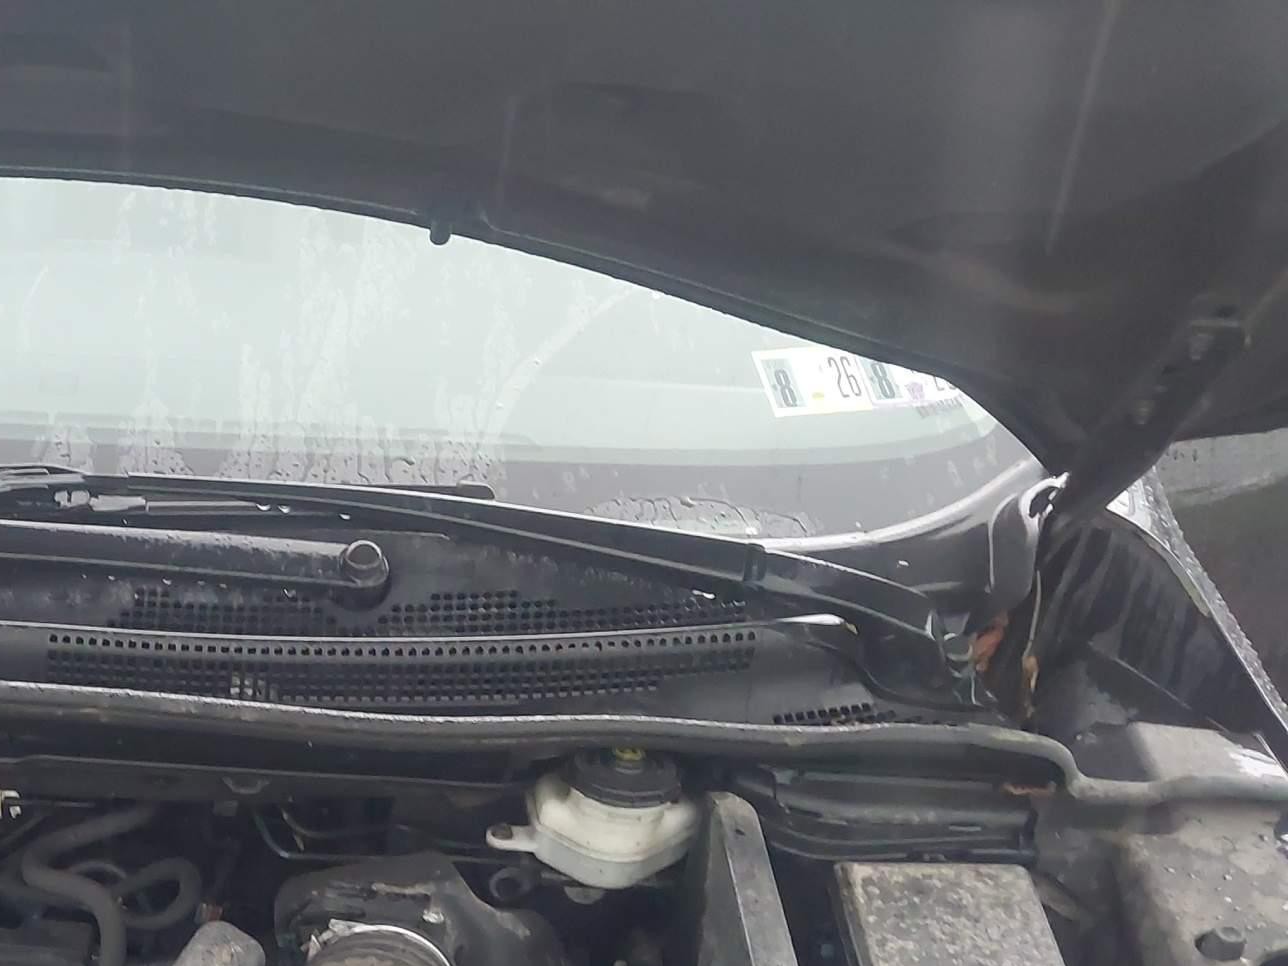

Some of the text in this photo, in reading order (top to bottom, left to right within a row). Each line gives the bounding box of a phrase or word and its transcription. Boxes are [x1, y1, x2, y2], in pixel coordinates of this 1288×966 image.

[773, 355, 862, 408] 8 26
[870, 361, 896, 400] 8
